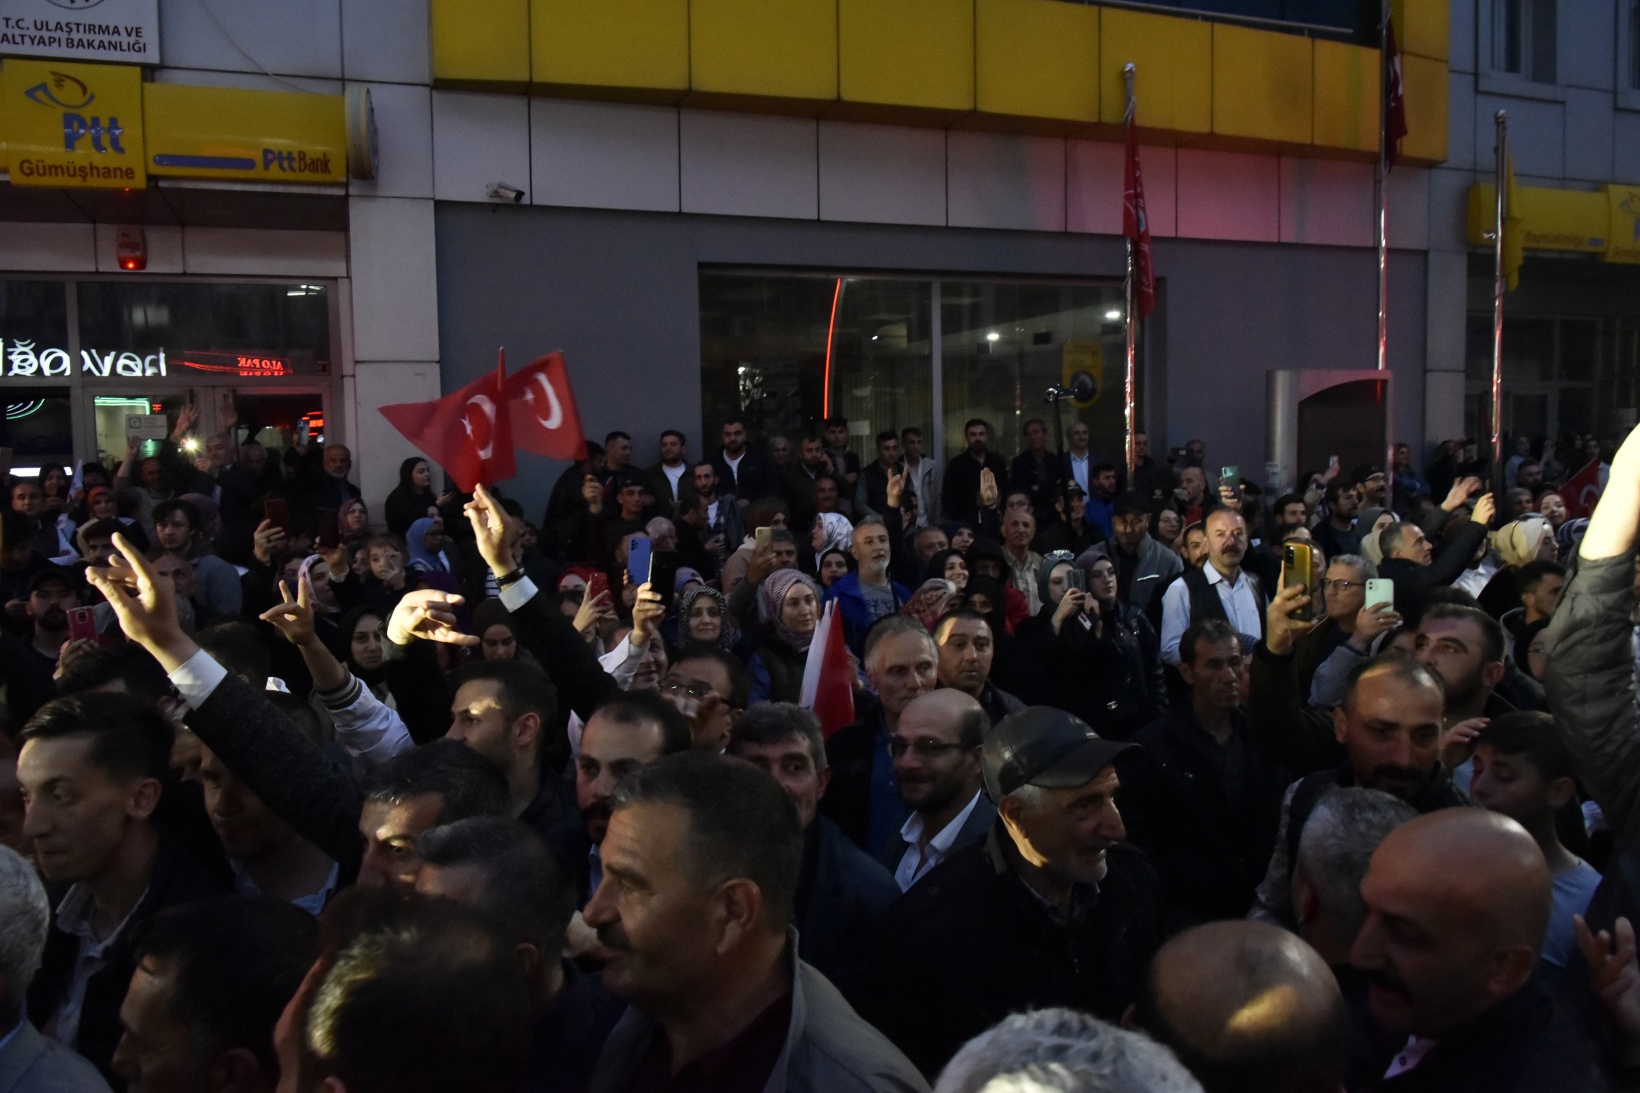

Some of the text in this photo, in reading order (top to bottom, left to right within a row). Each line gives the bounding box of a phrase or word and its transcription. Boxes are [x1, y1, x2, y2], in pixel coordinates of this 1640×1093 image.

[2, 17, 143, 38] T.C. ULAŞTIRMA VE
[0, 33, 147, 54] ALTYAPI BAKANLIĞI
[63, 112, 125, 154] Ptt
[19, 159, 135, 182] Gümüşhane
